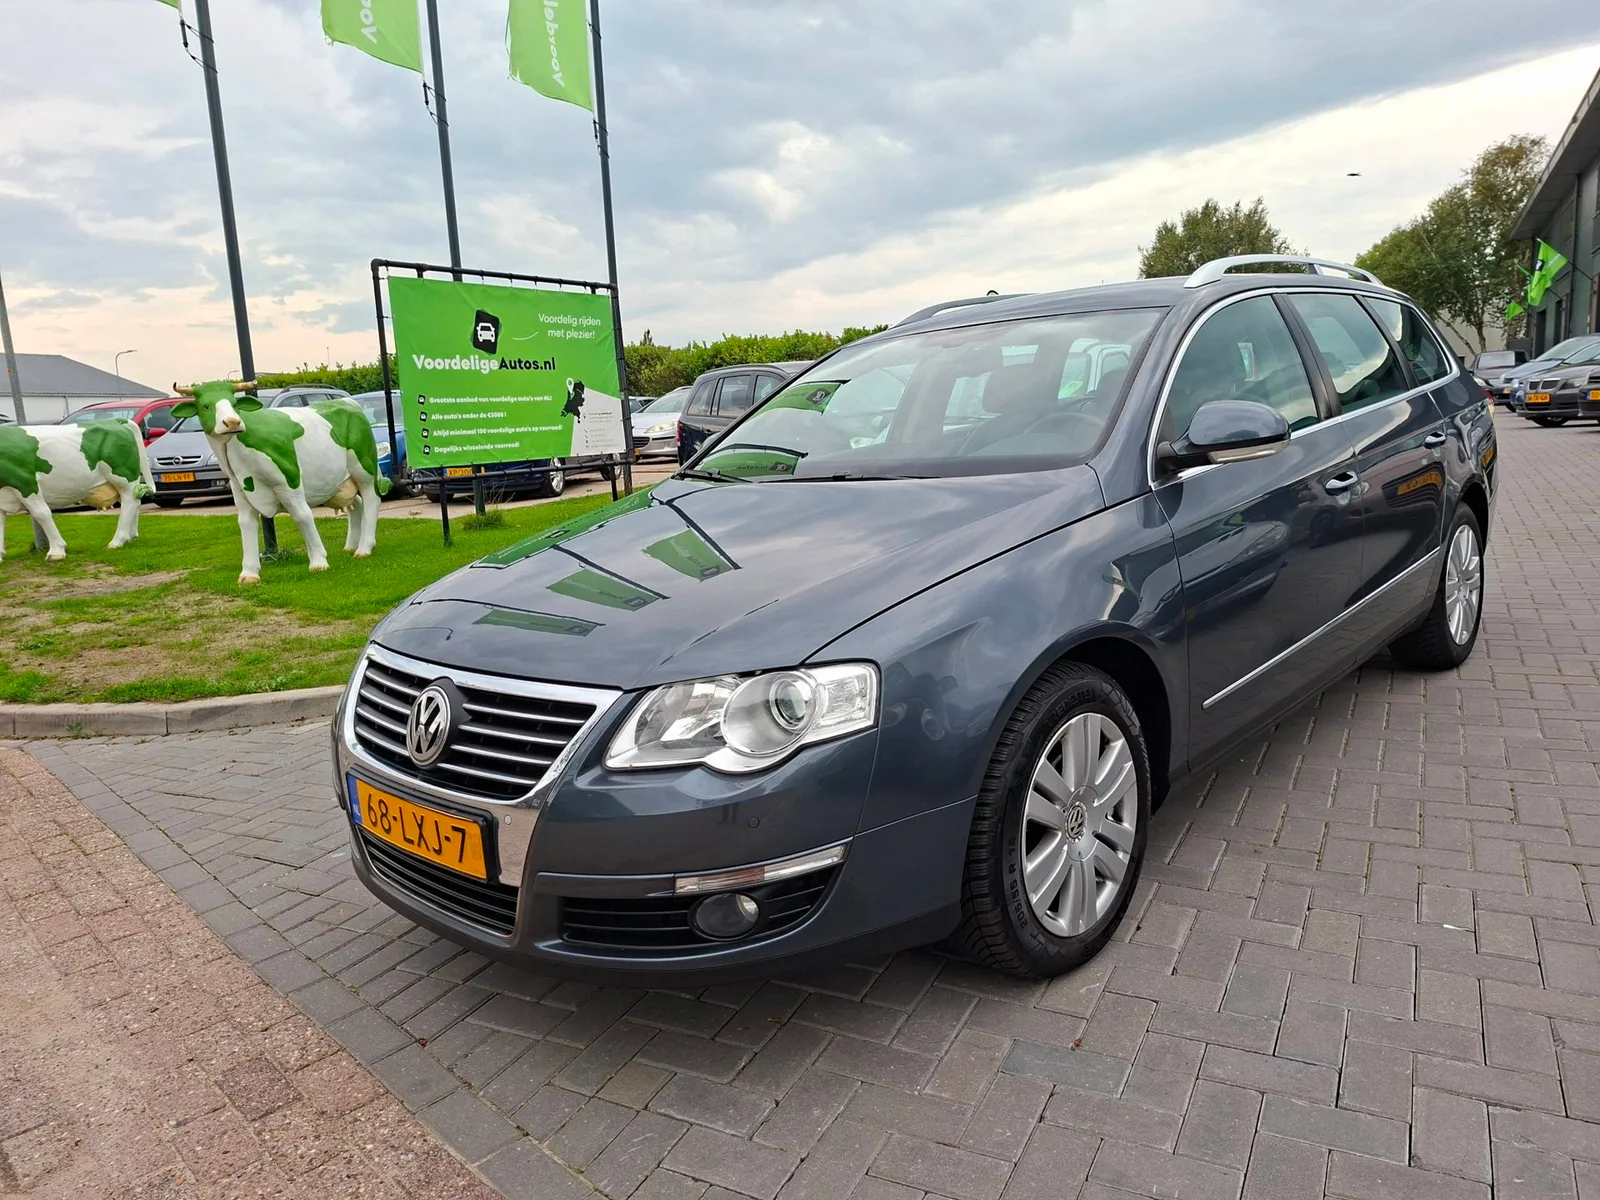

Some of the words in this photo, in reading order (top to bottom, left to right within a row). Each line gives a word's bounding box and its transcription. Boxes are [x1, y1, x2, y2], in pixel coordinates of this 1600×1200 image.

[538, 313, 577, 327] Voordelig
[579, 316, 601, 327] rijden
[548, 329, 565, 338] met
[566, 329, 596, 340] plezier!
[412, 354, 556, 374] VoordeligeAutos.nl
[487, 426, 515, 434] voordelige
[367, 793, 466, 863] 68-LXJ-7
[1008, 863, 1016, 874] R
[1009, 879, 1028, 929] 205/55
